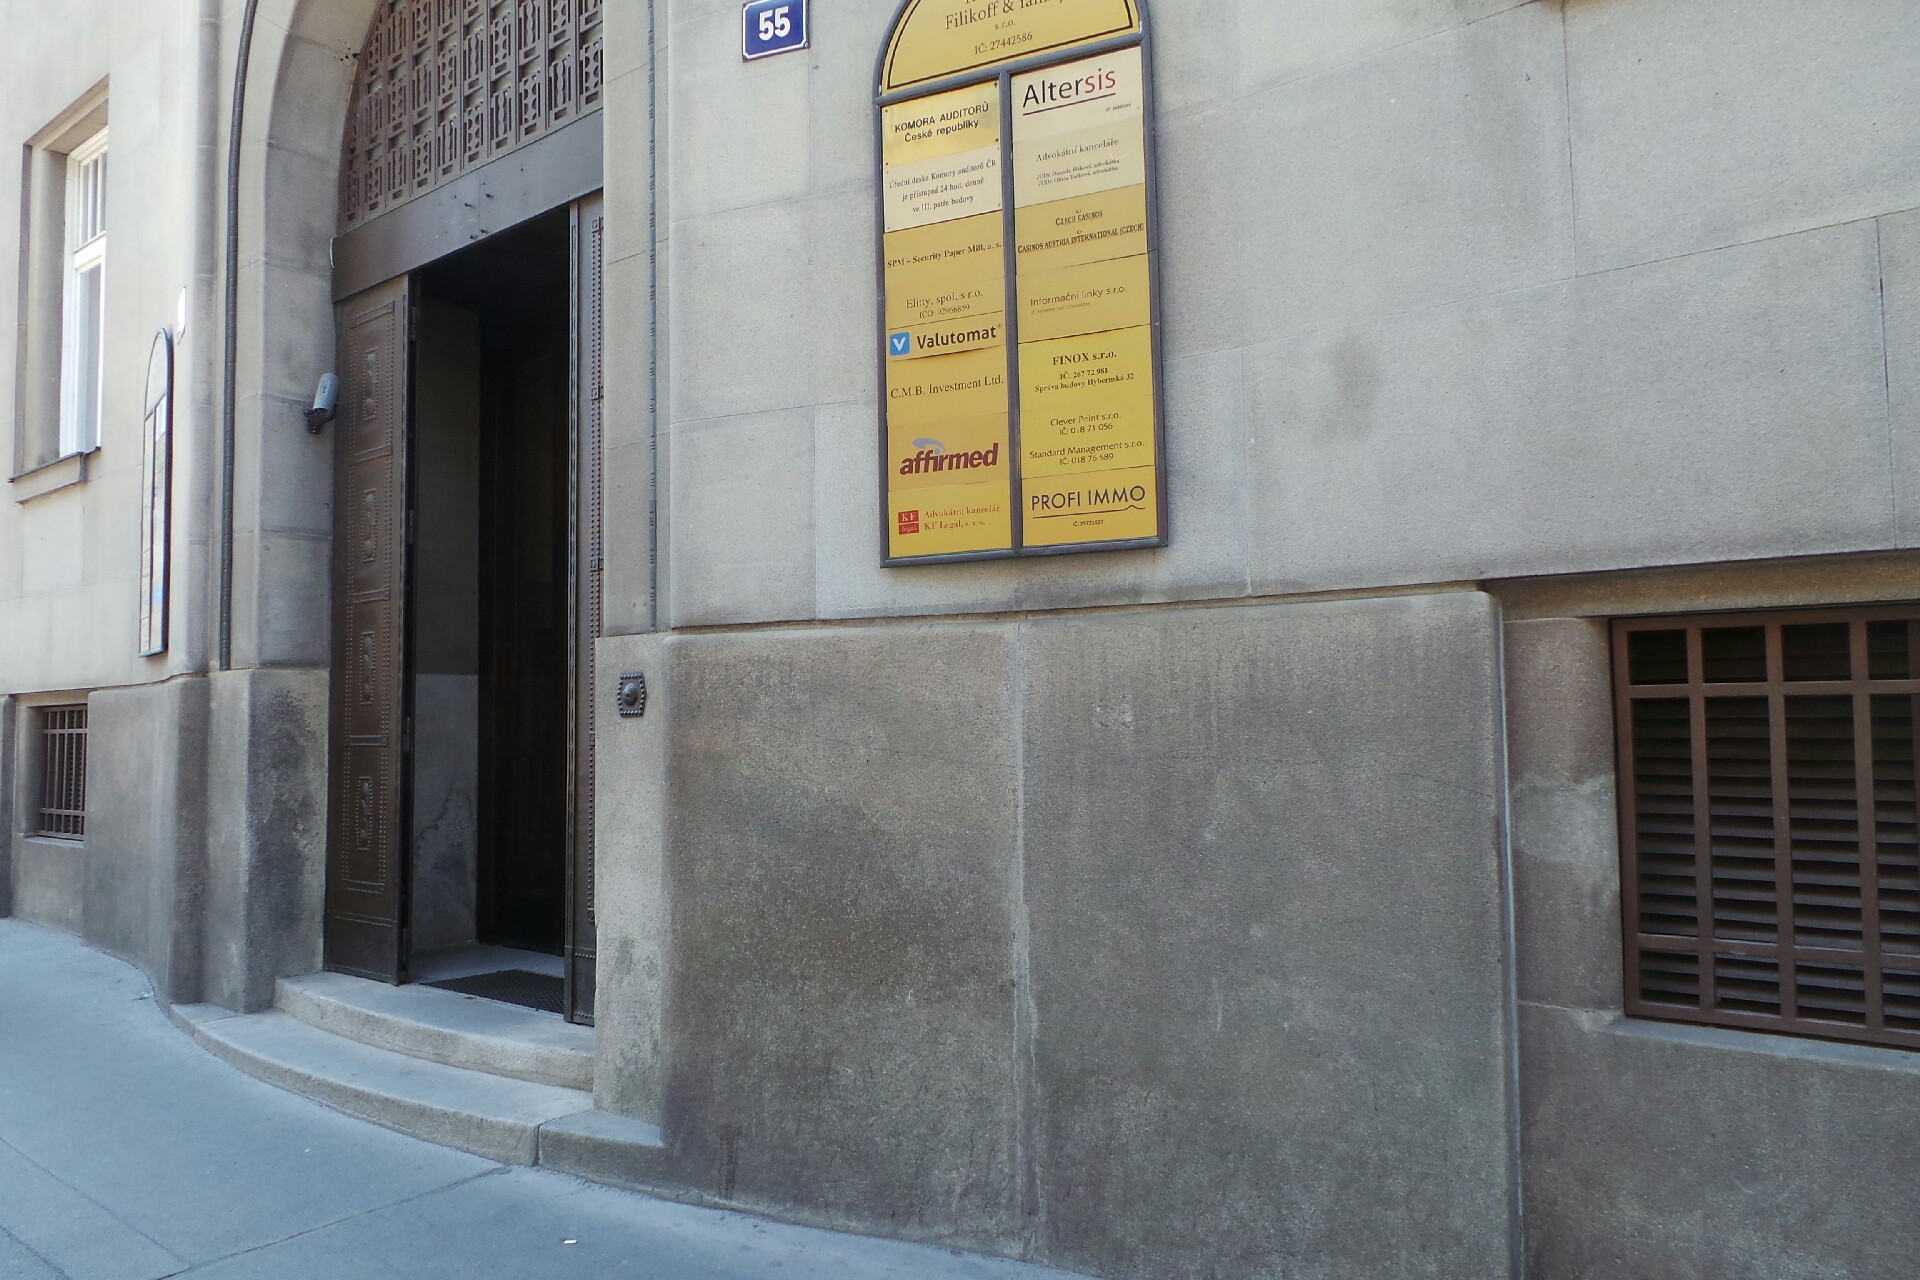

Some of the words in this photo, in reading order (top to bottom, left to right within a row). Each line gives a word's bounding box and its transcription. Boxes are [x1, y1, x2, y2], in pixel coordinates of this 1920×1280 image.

[759, 6, 791, 40] 55
[945, 2, 998, 30] Filikoff
[990, 32, 1032, 51] 27442586
[1023, 68, 1116, 108] Altersis
[895, 116, 935, 133] KOMORA
[940, 101, 988, 122] AUDITORŮ
[904, 130, 932, 142] České
[936, 120, 978, 135] republiky
[931, 170, 956, 180] Komory
[986, 159, 996, 168] ČR
[951, 194, 973, 204] budovy
[1044, 238, 1070, 248] AUSTRIA
[1071, 228, 1118, 243] INTERNATIONAL
[888, 258, 904, 268] SPM
[912, 252, 942, 263] Security
[944, 248, 965, 258] Paper
[1031, 292, 1079, 306] Informační
[1082, 289, 1103, 298] linky
[917, 326, 996, 349] Valutomat
[1053, 352, 1089, 365] FINOX
[1093, 351, 1116, 360] s.r.o.
[891, 386, 925, 398] C.M.B.
[930, 379, 981, 393] Investment
[985, 375, 1003, 386] Ltd.
[1035, 385, 1058, 393] Správa
[1061, 381, 1085, 389] budovy
[1088, 375, 1124, 386] Hybernská
[1050, 418, 1075, 426] Clever
[900, 442, 998, 475] affirmed
[1030, 448, 1065, 458] Standard
[1068, 442, 1122, 455] Management
[1032, 491, 1080, 510] PROFI
[1089, 486, 1145, 505] IMMO
